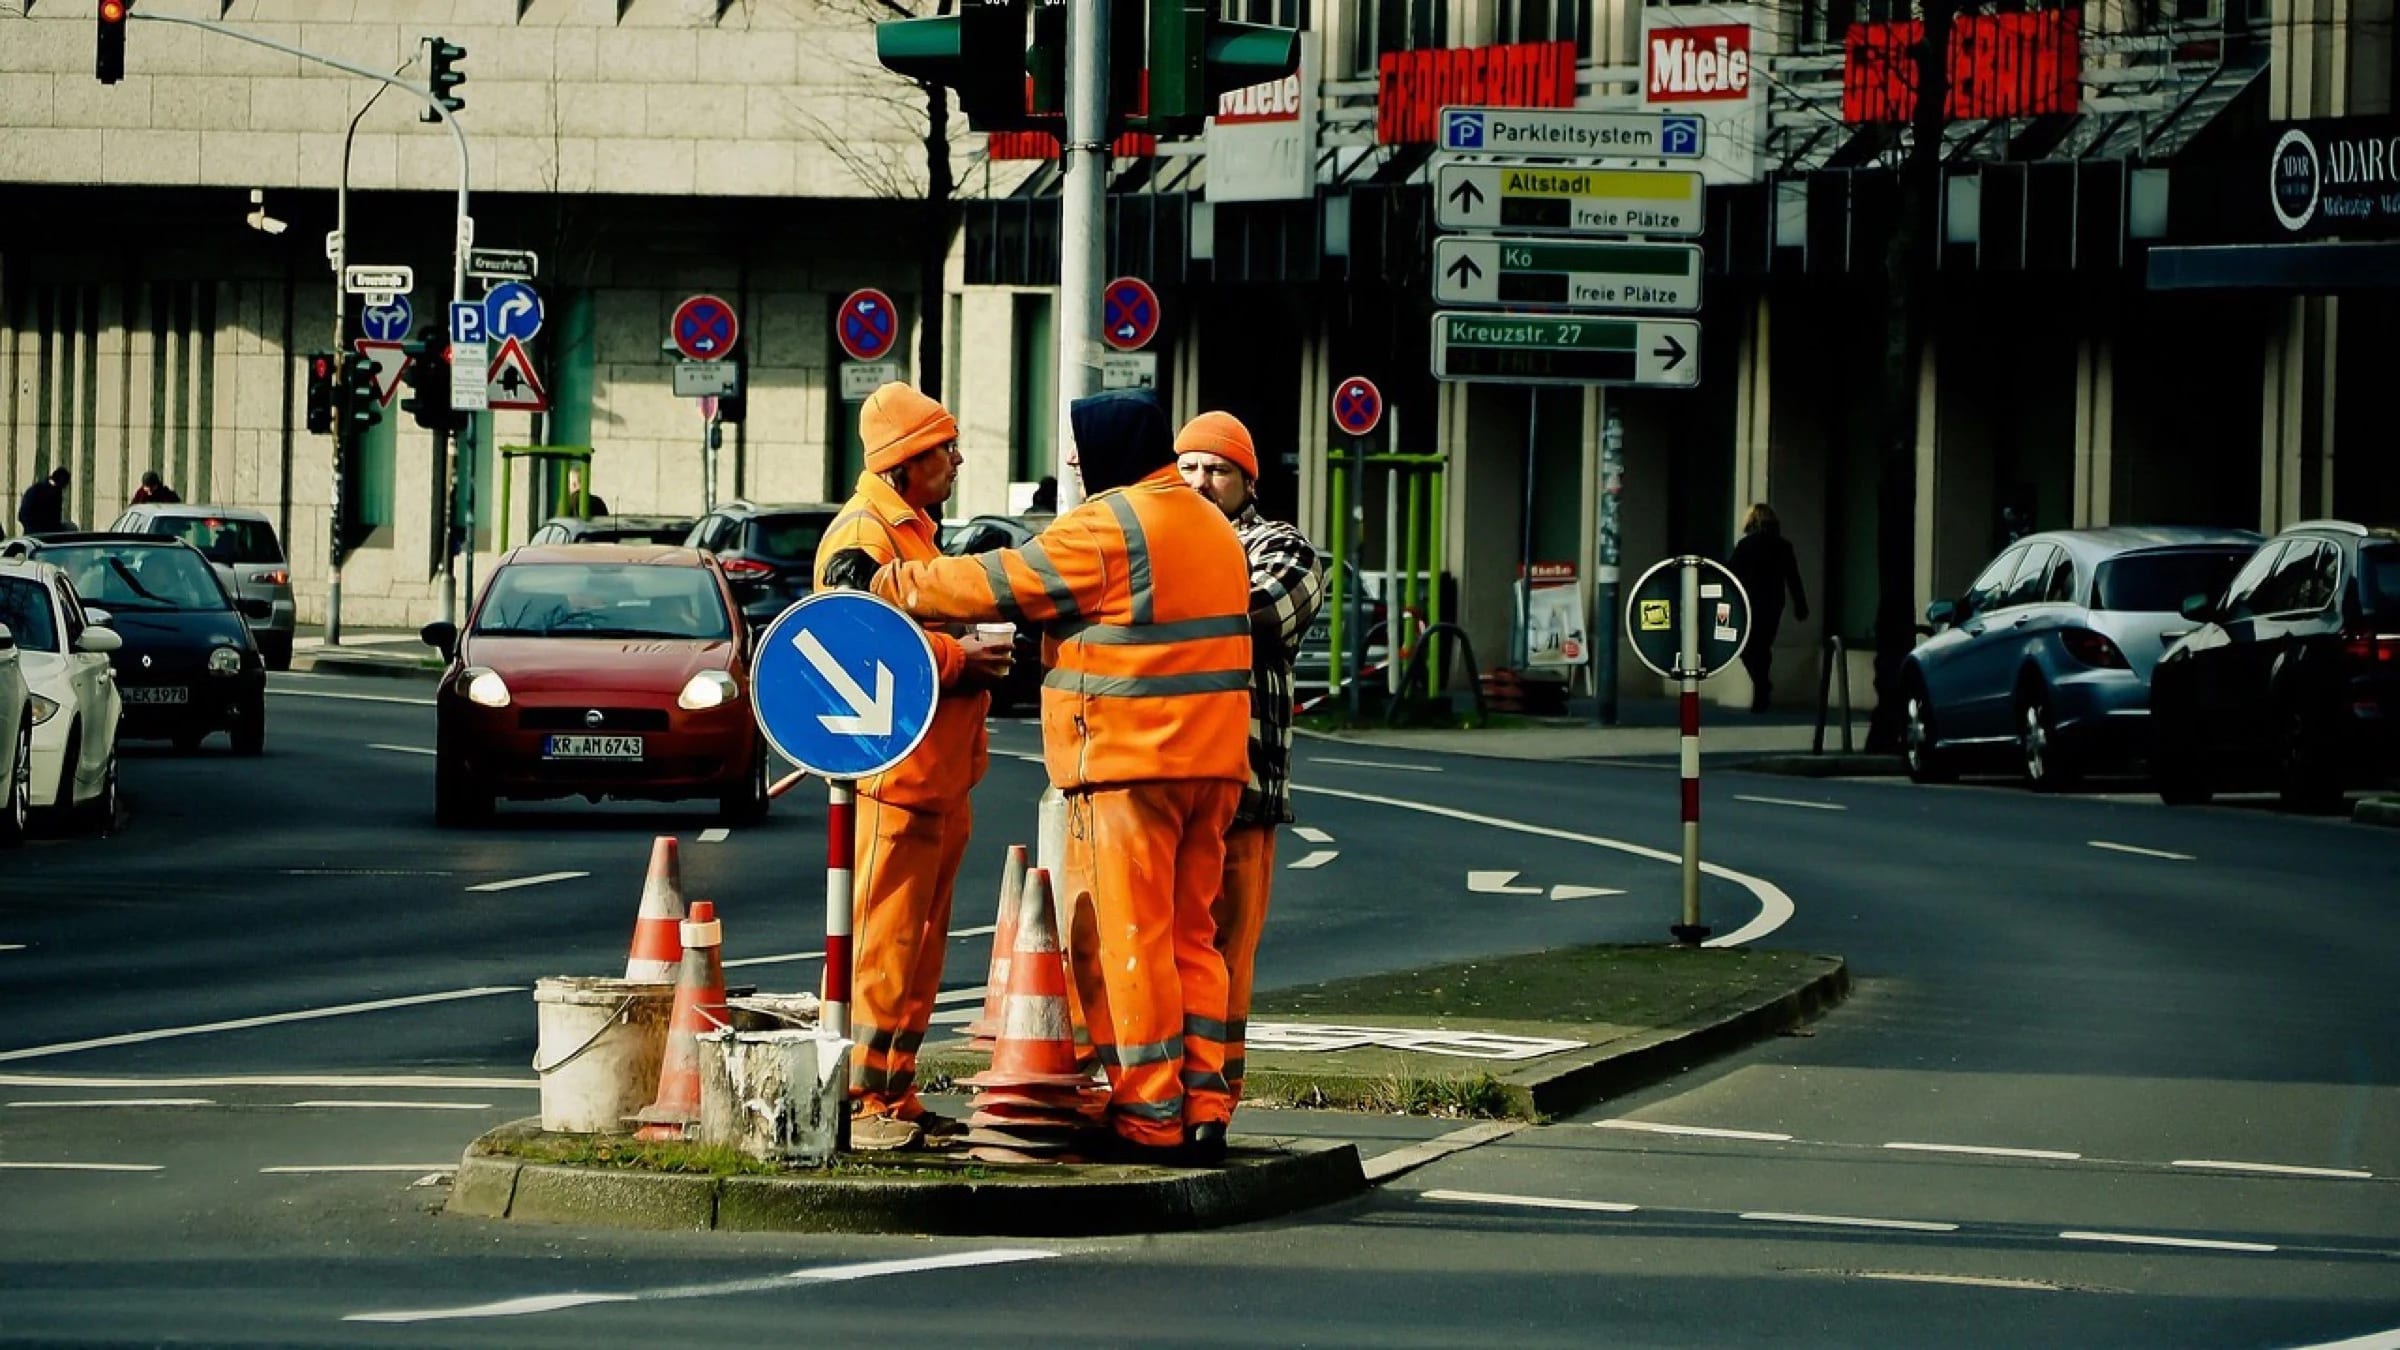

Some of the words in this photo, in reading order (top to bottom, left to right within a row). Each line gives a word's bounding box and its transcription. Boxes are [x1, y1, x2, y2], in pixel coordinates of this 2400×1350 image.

[1652, 36, 1749, 93] Miele
[1492, 121, 1653, 148] Parkleitsystem
[2324, 138, 2384, 184] ADAR
[1508, 173, 1591, 194] Altstadt
[1577, 209, 1618, 226] freie
[1626, 210, 1680, 228] Plätze
[1576, 285, 1615, 301] freie
[1624, 286, 1678, 303] Plätze
[1452, 322, 1547, 343] Kreuzstr.
[1557, 325, 1582, 344] 27
[553, 738, 571, 753] KR
[605, 738, 640, 754] 6743
